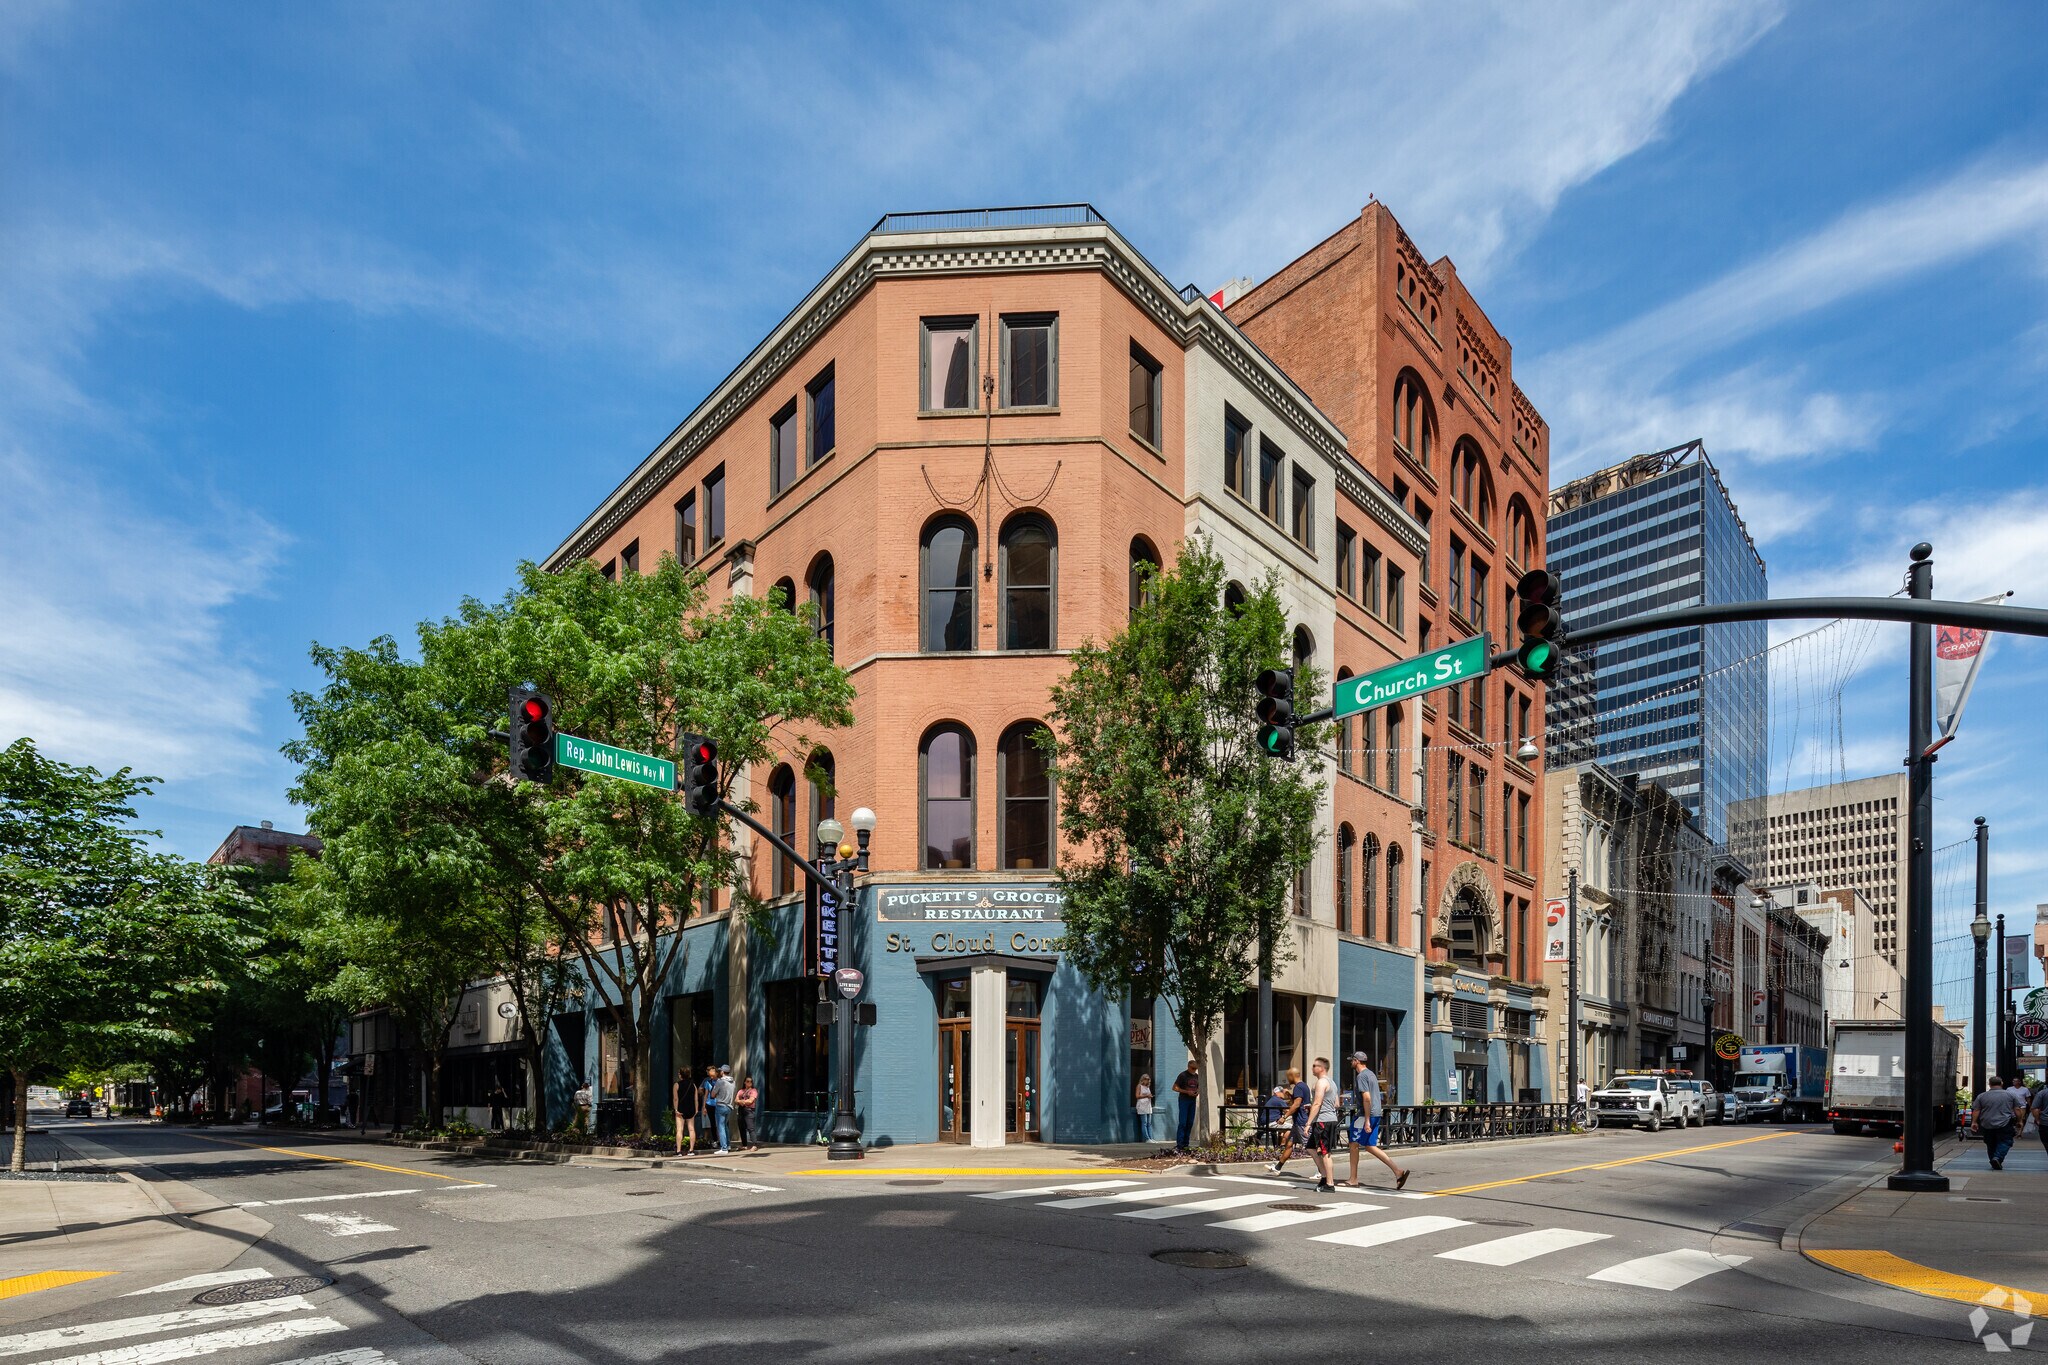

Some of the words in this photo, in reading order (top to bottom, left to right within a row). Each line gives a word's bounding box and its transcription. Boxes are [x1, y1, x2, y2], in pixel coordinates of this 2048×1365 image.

[1944, 640, 1982, 653] CRAWL
[1354, 671, 1427, 704] Church
[1433, 654, 1463, 680] St
[566, 740, 587, 764] Rep.
[589, 746, 613, 768] John
[615, 753, 640, 774] Lewis
[643, 764, 657, 781] Way
[659, 765, 665, 782] N
[887, 890, 978, 907] PUCKETT'S
[992, 890, 1067, 904] GROCE
[821, 863, 838, 974] CKETTS
[924, 909, 1045, 920] RESTAURANT
[886, 933, 916, 952] St.
[931, 931, 996, 953] Cloud
[1663, 1016, 1674, 1027] ARTS
[2023, 1024, 2040, 1037] JJ
